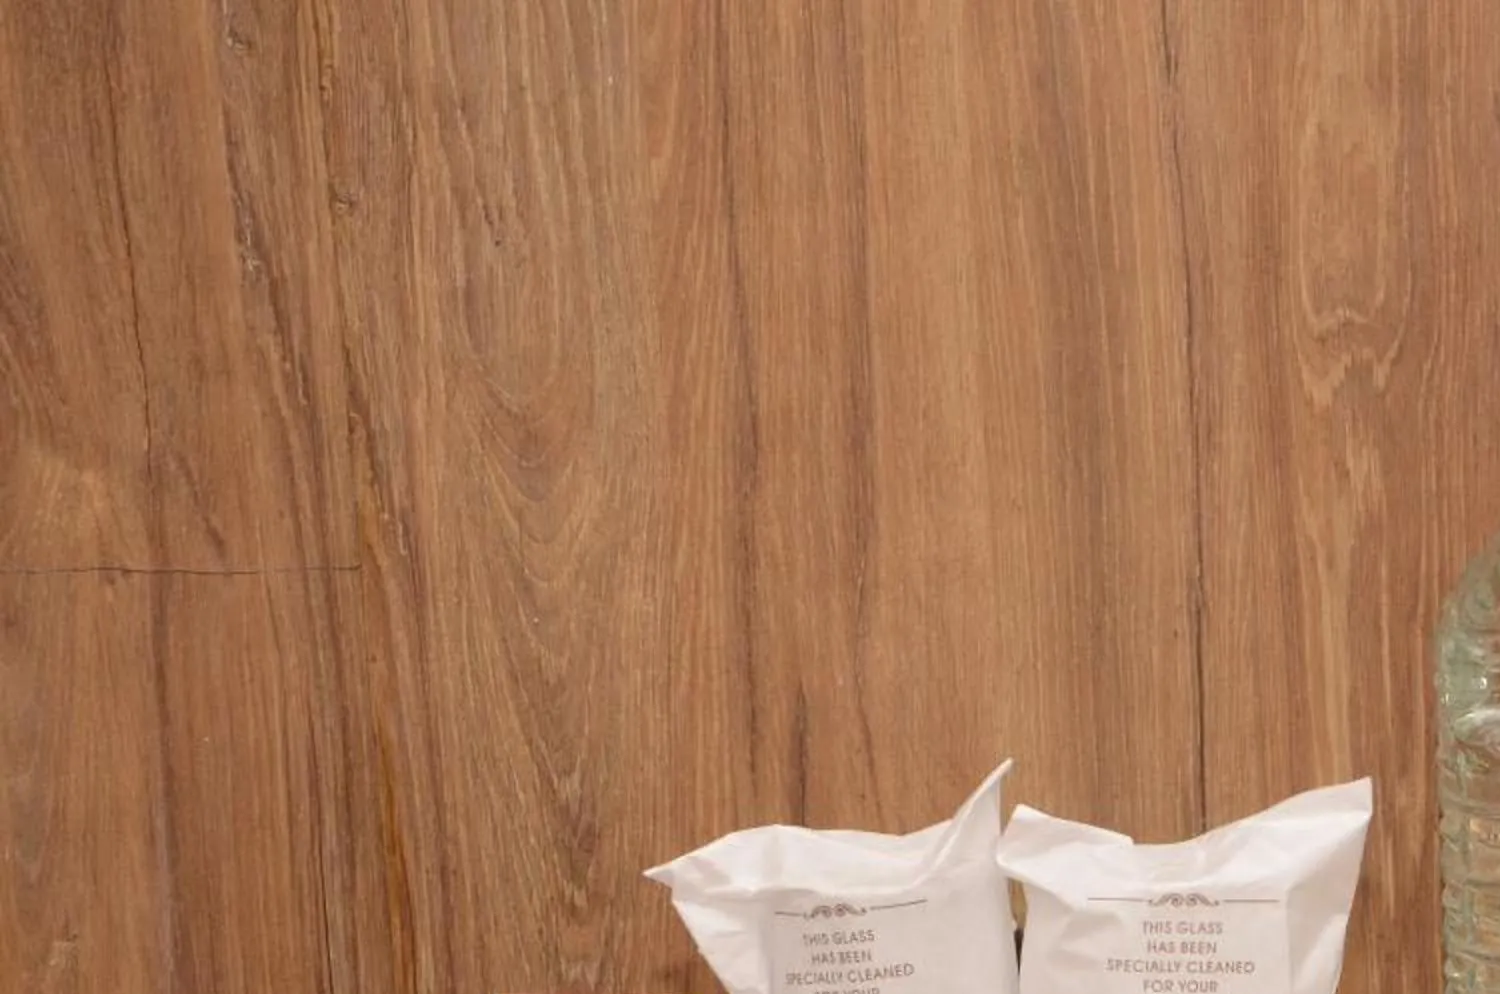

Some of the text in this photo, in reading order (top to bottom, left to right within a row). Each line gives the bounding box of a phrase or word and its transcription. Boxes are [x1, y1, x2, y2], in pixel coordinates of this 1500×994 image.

[1142, 920, 1223, 935] THIS GLASS
[803, 929, 876, 946] THIS GLASS
[1146, 941, 1217, 955] HAS BEEN
[811, 950, 872, 965] HAS BEEN
[1106, 958, 1255, 974] SPECIALLY CLEANED
[785, 963, 915, 987] SPECIALLY CLEANED
[1143, 979, 1218, 993] FOR YOUR
